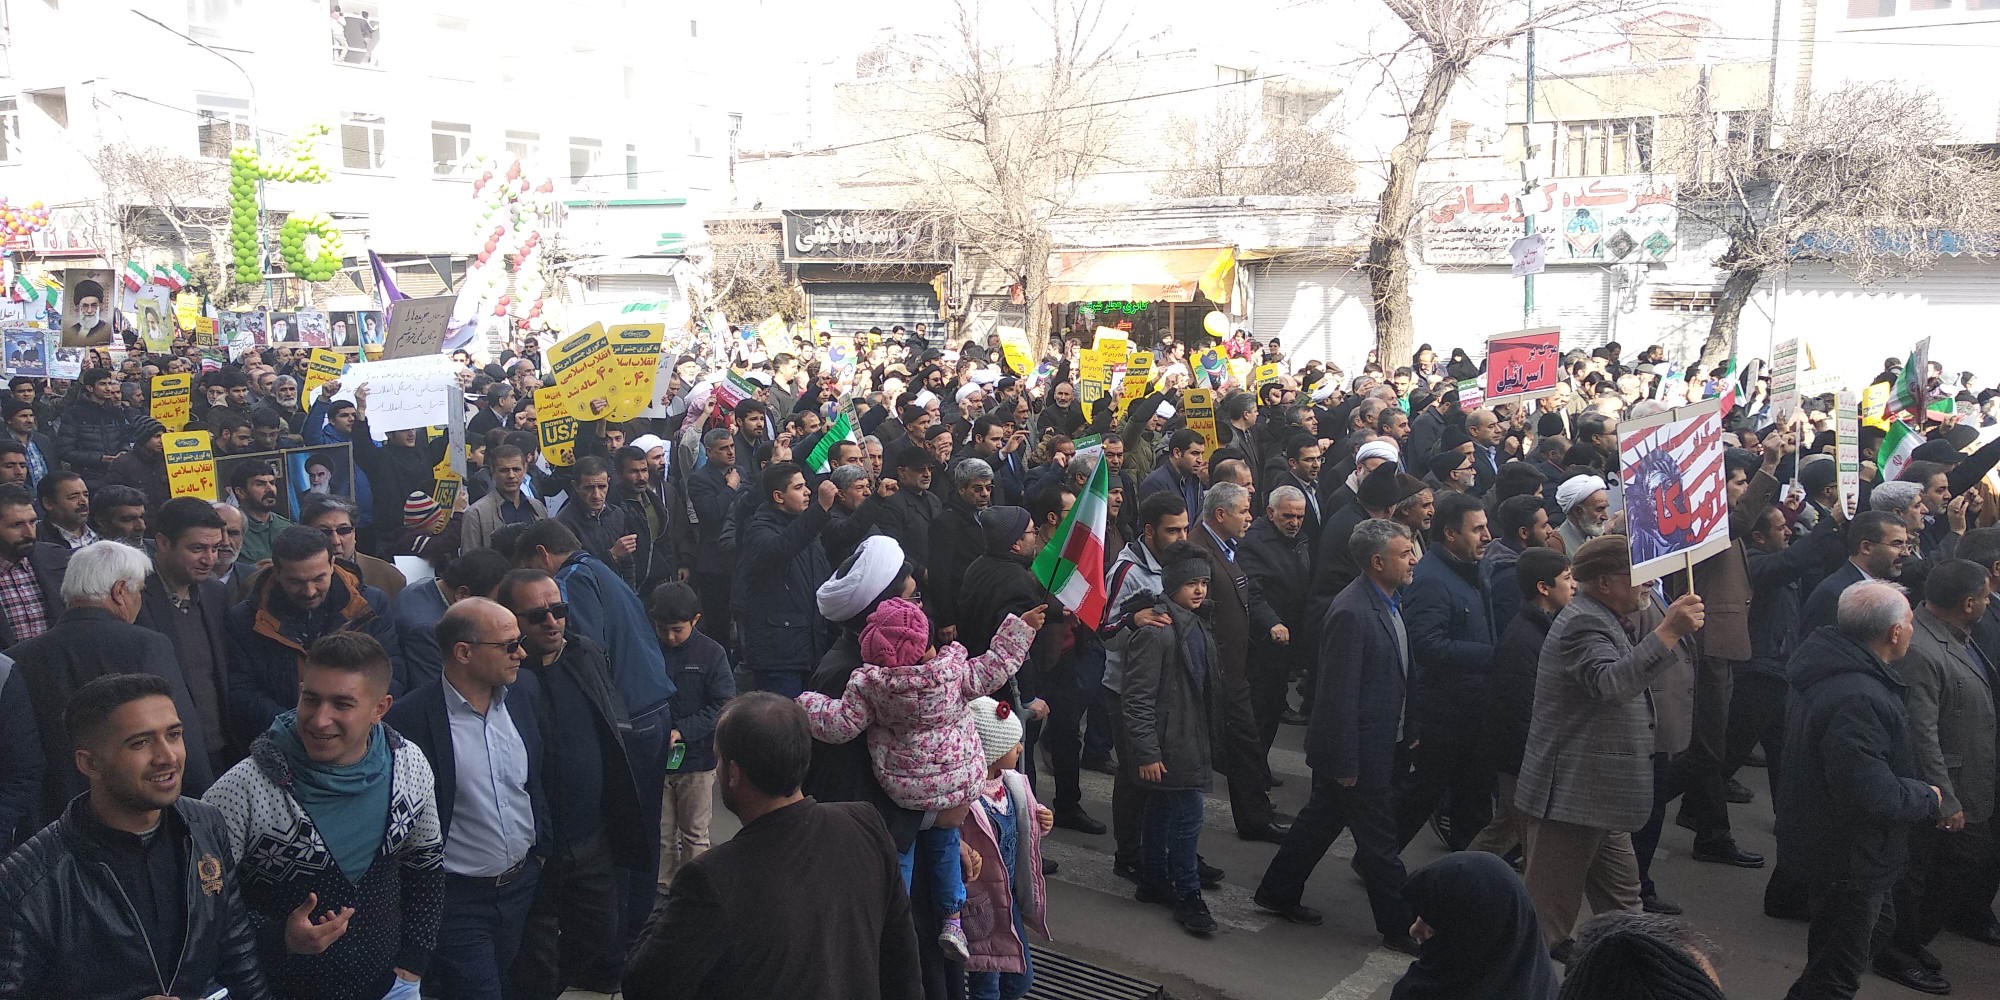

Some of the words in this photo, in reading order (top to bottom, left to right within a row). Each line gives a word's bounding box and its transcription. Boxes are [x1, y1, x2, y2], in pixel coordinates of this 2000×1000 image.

[624, 345, 638, 354] چشم
[638, 345, 653, 353] کوری
[1527, 347, 1536, 362] بر
[1539, 342, 1557, 358] مرگ
[588, 349, 611, 368] انقلاب
[617, 358, 631, 366] اسلا
[634, 358, 656, 368] انقلاب
[560, 363, 588, 386] اسلامی
[1496, 361, 1544, 392] اسرائیل
[580, 379, 598, 392] ساله
[567, 387, 580, 399] شد
[1084, 386, 1100, 401] USA
[153, 398, 173, 408] اسلامی
[173, 396, 188, 405] انقلاب
[546, 423, 578, 444] USA
[168, 454, 182, 462] آمریکا
[171, 466, 194, 478] اسلامی
[194, 463, 212, 473] انقلاب
[175, 486, 185, 494] شد
[186, 484, 199, 493] ساله
[200, 477, 213, 491] ۴۰
